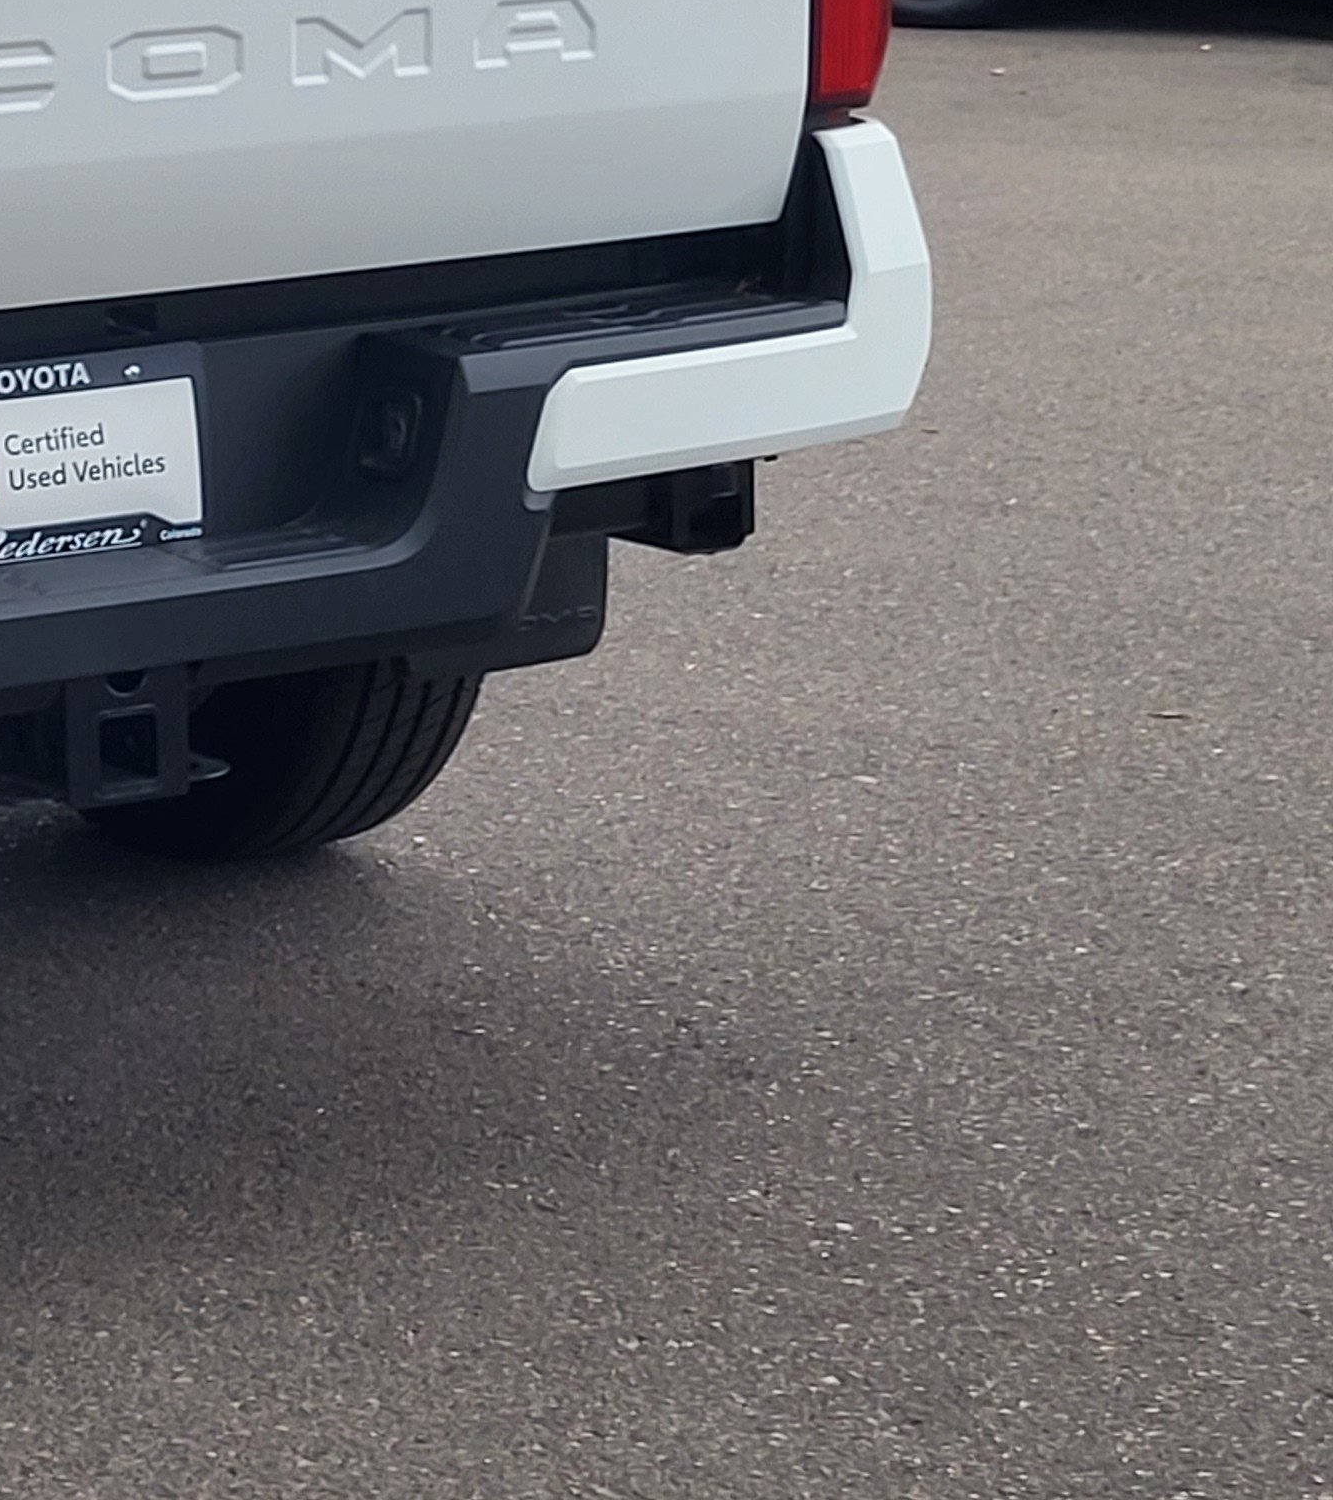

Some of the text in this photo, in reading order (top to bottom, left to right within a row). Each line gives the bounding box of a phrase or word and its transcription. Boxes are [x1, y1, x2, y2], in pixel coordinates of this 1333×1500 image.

[3, 422, 105, 457] Certified
[8, 452, 167, 492] Used Vehicles
